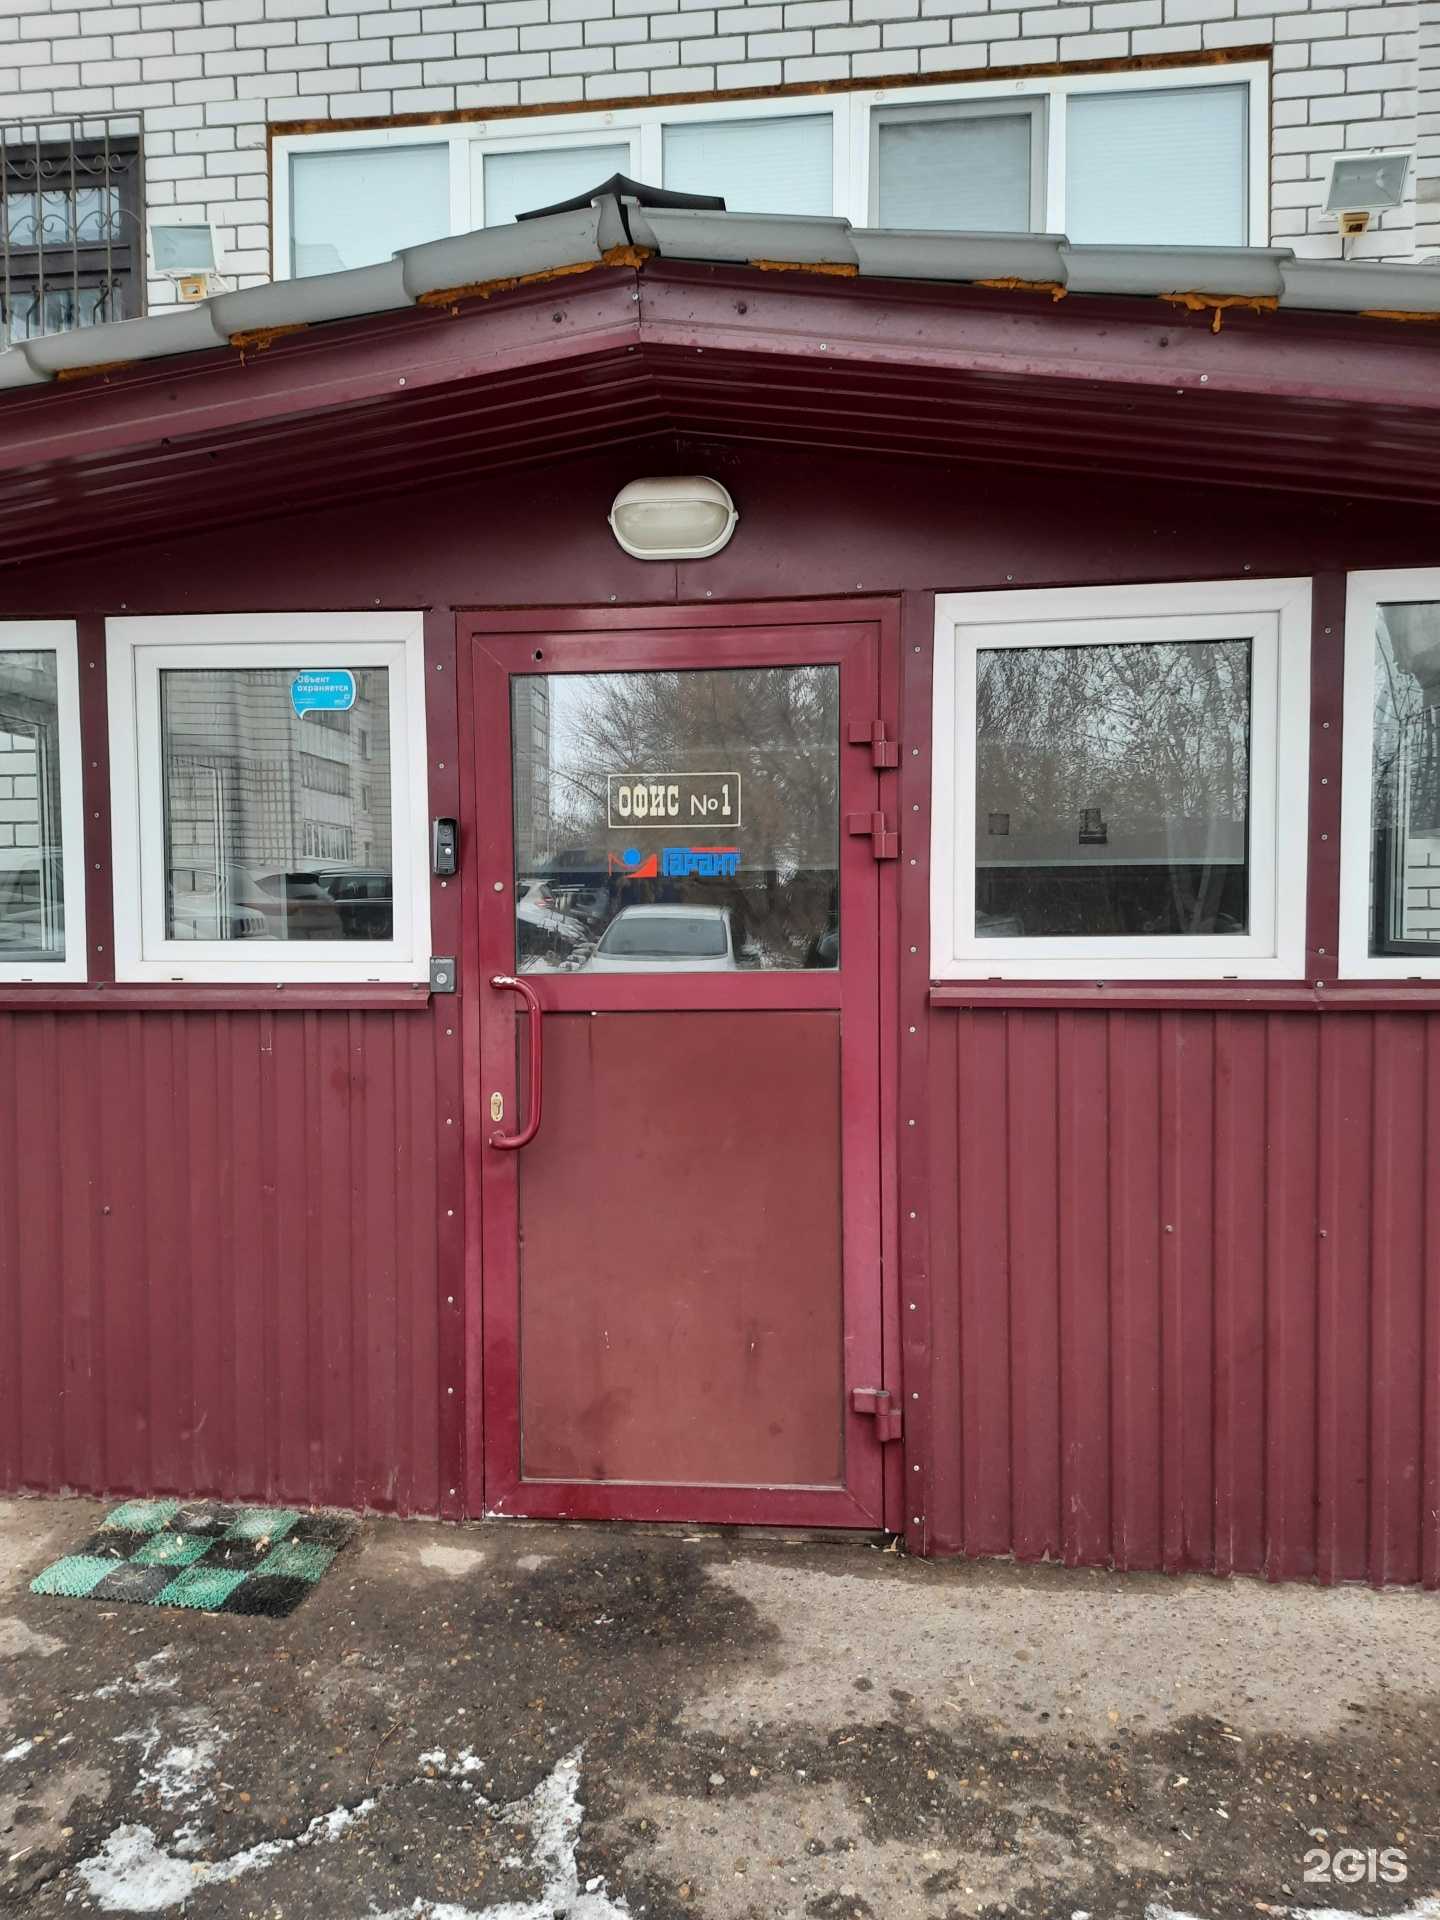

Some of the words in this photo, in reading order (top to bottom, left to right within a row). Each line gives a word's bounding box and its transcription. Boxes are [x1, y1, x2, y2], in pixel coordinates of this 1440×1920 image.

[296, 675, 330, 683] Объект
[296, 685, 349, 693] охраняется
[618, 783, 680, 818] ОФИС
